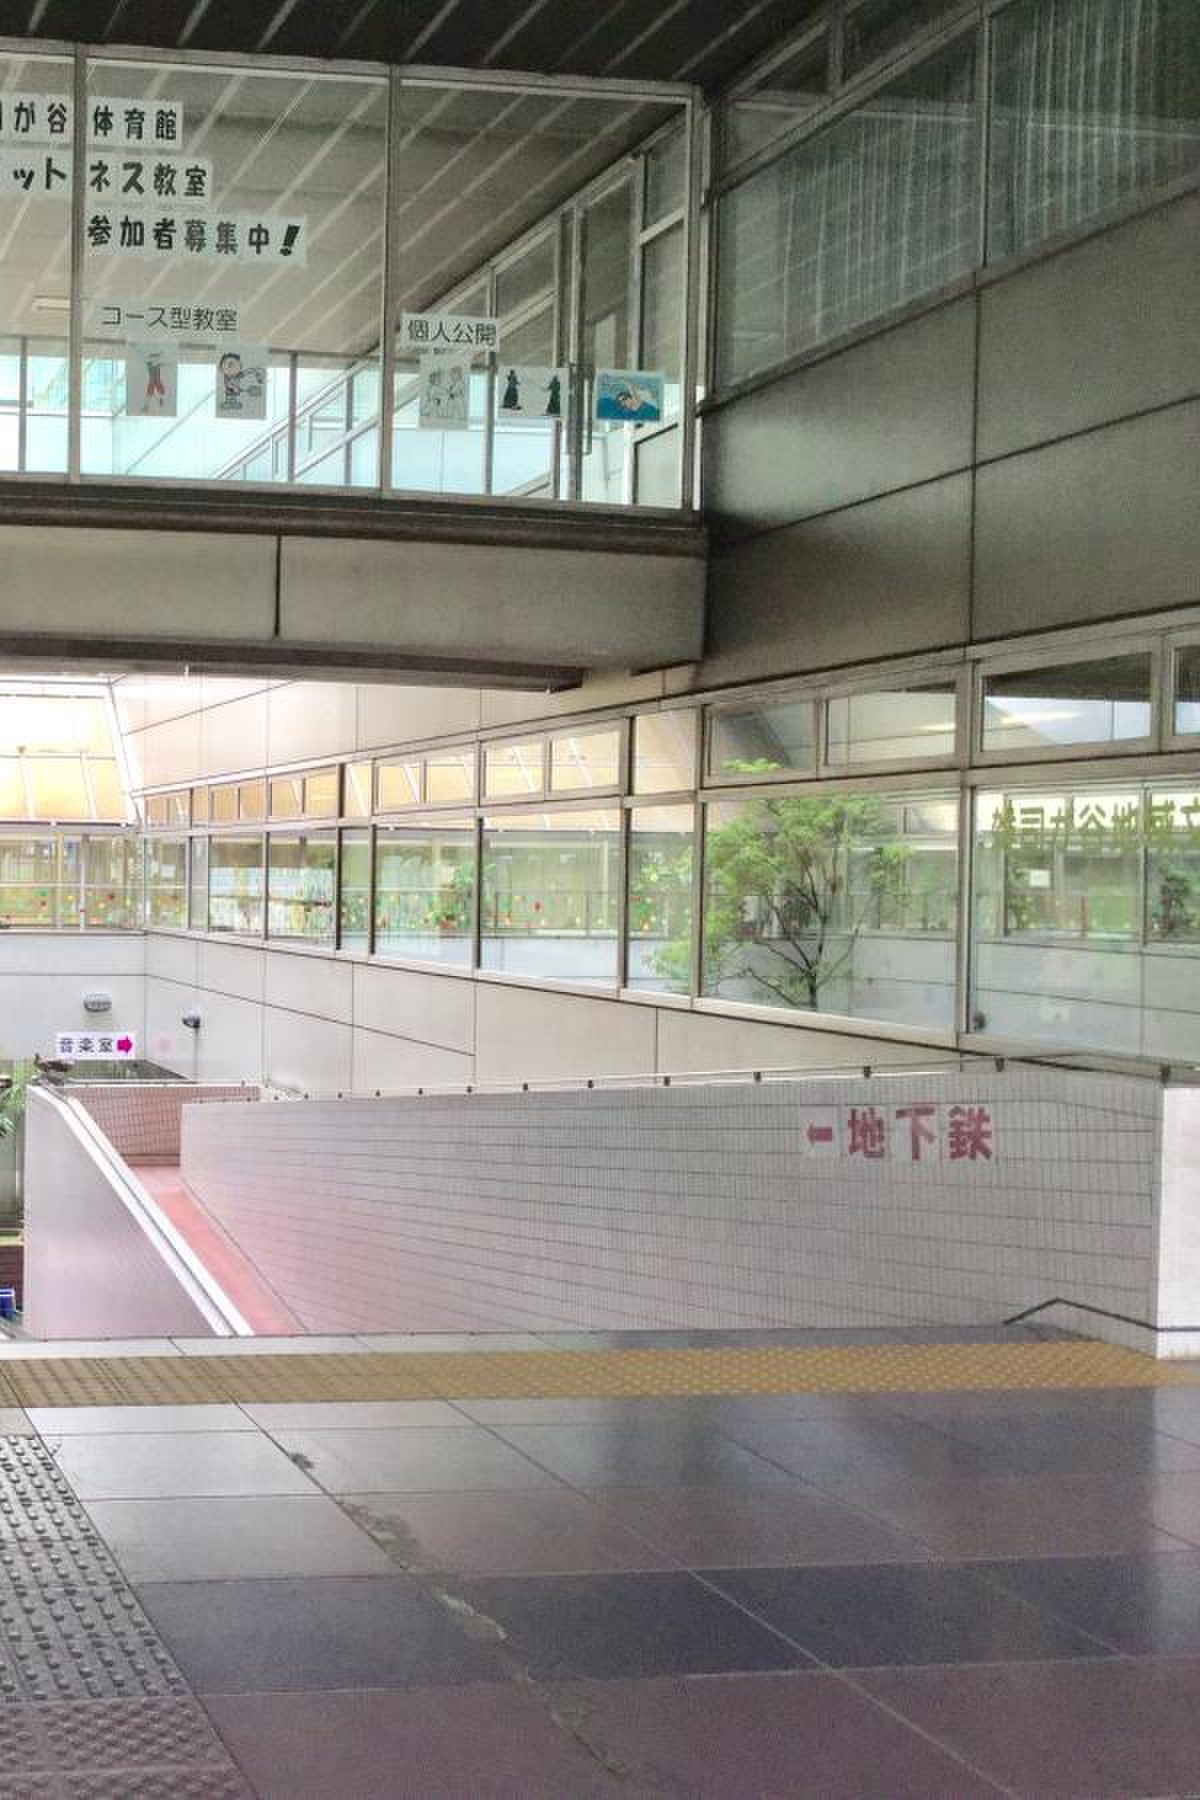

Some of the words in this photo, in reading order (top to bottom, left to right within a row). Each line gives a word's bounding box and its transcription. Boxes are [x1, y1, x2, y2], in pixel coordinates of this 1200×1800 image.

[101, 305, 238, 332] コース型教室
[407, 319, 497, 346] 個人公開
[847, 1105, 993, 1161] 地下鉄
